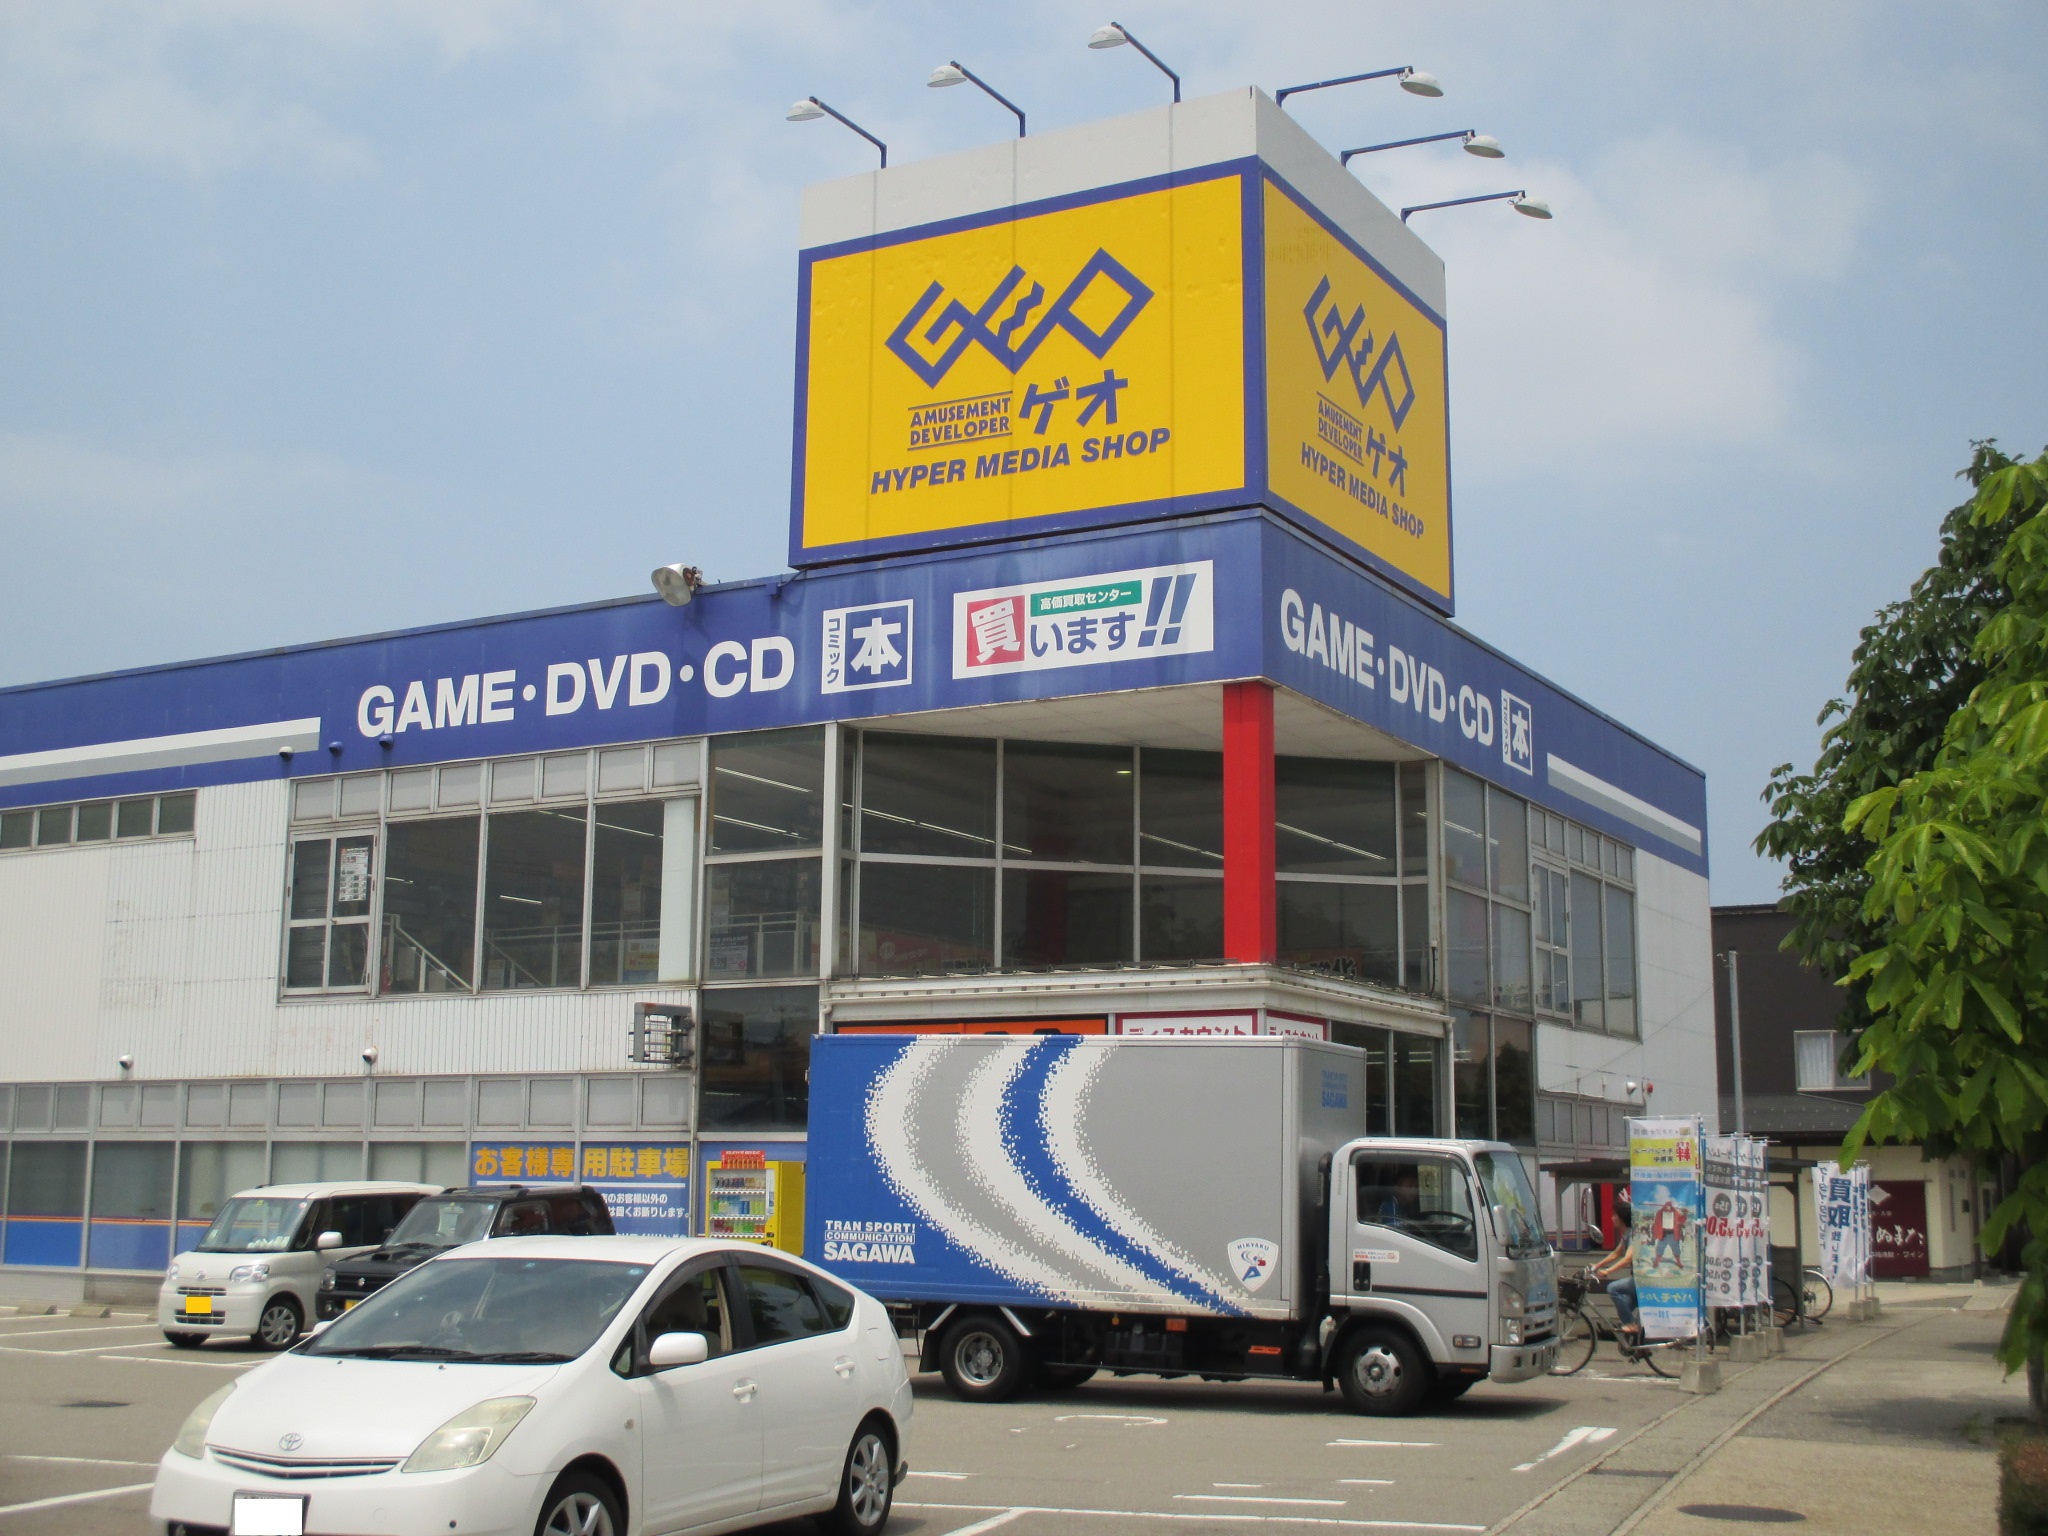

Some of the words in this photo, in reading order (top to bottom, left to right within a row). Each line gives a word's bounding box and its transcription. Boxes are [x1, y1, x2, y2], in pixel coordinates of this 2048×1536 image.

[910, 397, 1011, 428] AMUSEMENT
[1018, 368, 1128, 435] ゲオ
[1318, 399, 1363, 441] AMUSEMENT
[909, 416, 1010, 447] DEVELOPER
[1318, 420, 1363, 461] DEVELOPER
[871, 458, 966, 495] HYPER
[974, 442, 1070, 480] MEDIA
[1081, 427, 1171, 463] SHOP
[1366, 424, 1408, 498] ゲオ
[1301, 442, 1346, 491] HYPER
[1349, 474, 1388, 520] MEDIA
[1392, 506, 1424, 539] SHOP
[1040, 587, 1132, 611] 高価買取センター
[826, 617, 841, 685] コミック
[850, 617, 902, 675] 本
[1512, 710, 1528, 760] 本
[823, 1241, 916, 1264] SAGAWA
[826, 1231, 913, 1243] COMMUNICATION
[1237, 1242, 1269, 1251] HIKYAKU
